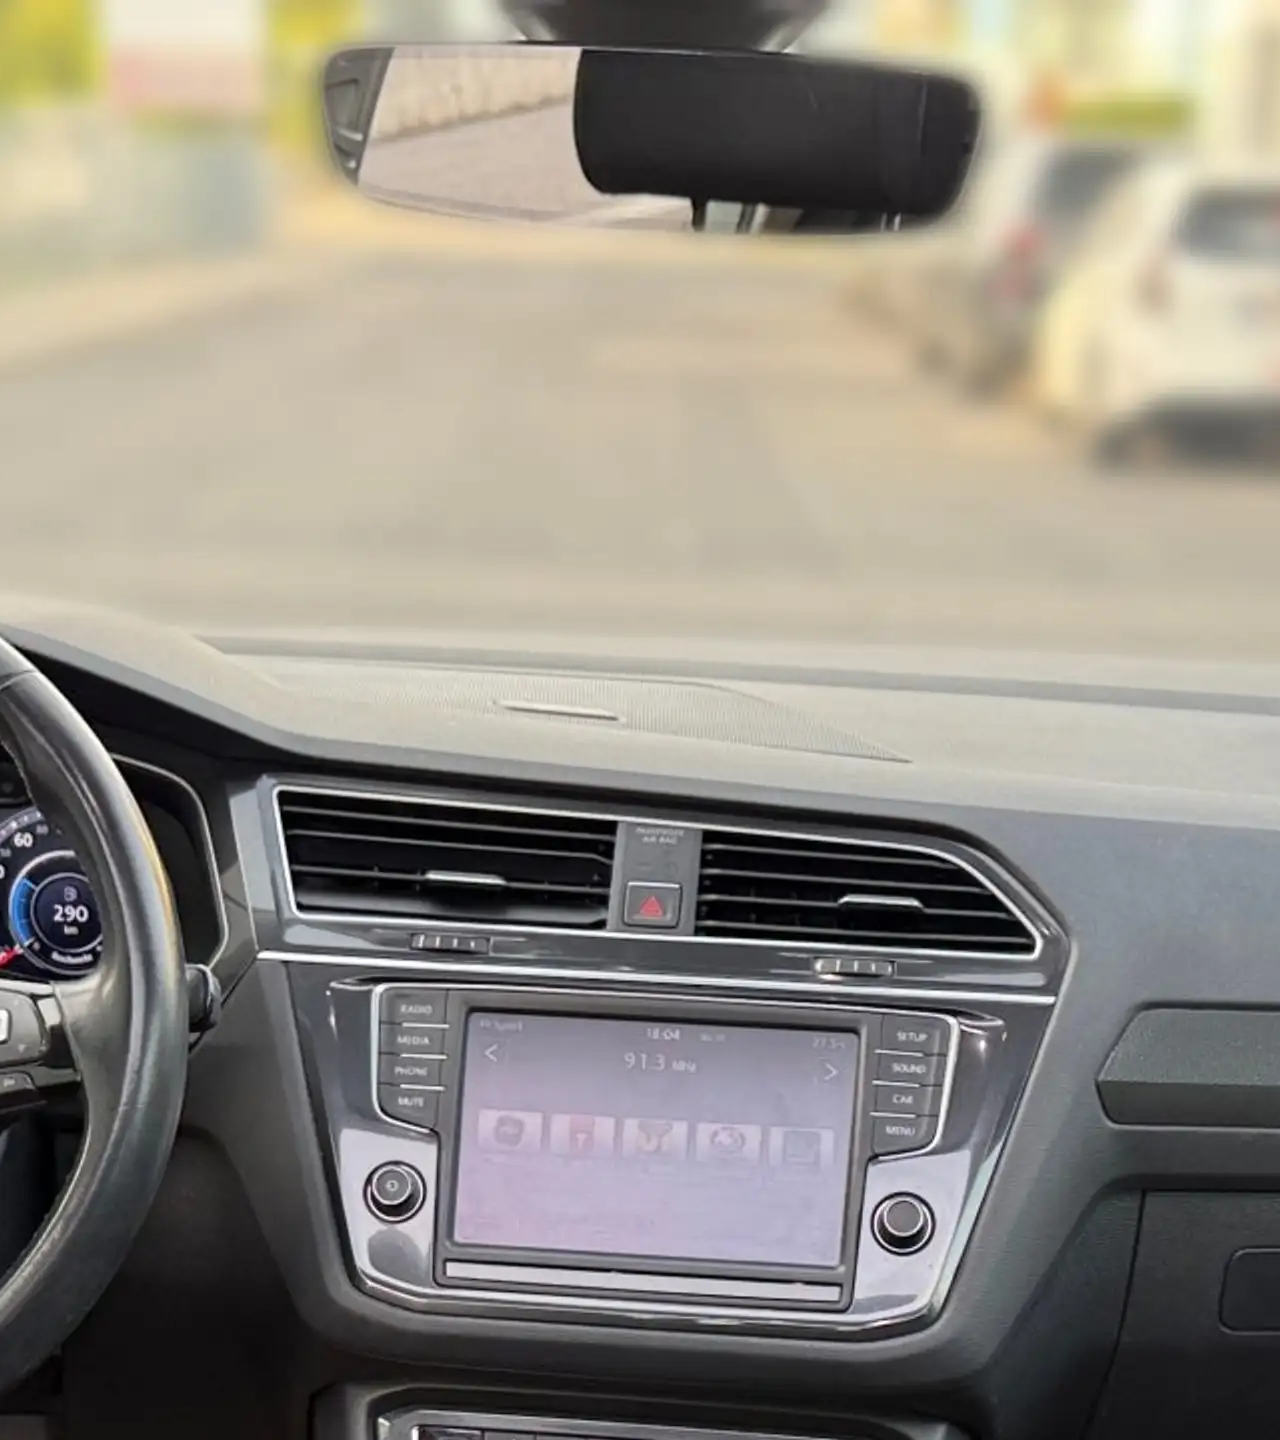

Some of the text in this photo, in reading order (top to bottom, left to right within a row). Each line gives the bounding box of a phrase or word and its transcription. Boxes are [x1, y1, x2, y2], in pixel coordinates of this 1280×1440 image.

[13, 832, 33, 847] 60
[53, 904, 89, 922] 290
[401, 1004, 433, 1015] RADIO
[397, 1035, 429, 1046] MEDIA
[896, 1031, 928, 1042] SETUP
[394, 1066, 428, 1077] PHONE
[892, 1062, 926, 1074] SOUND
[398, 1096, 424, 1107] MUTE
[892, 1094, 913, 1105] CAR
[885, 1125, 916, 1137] MENU
